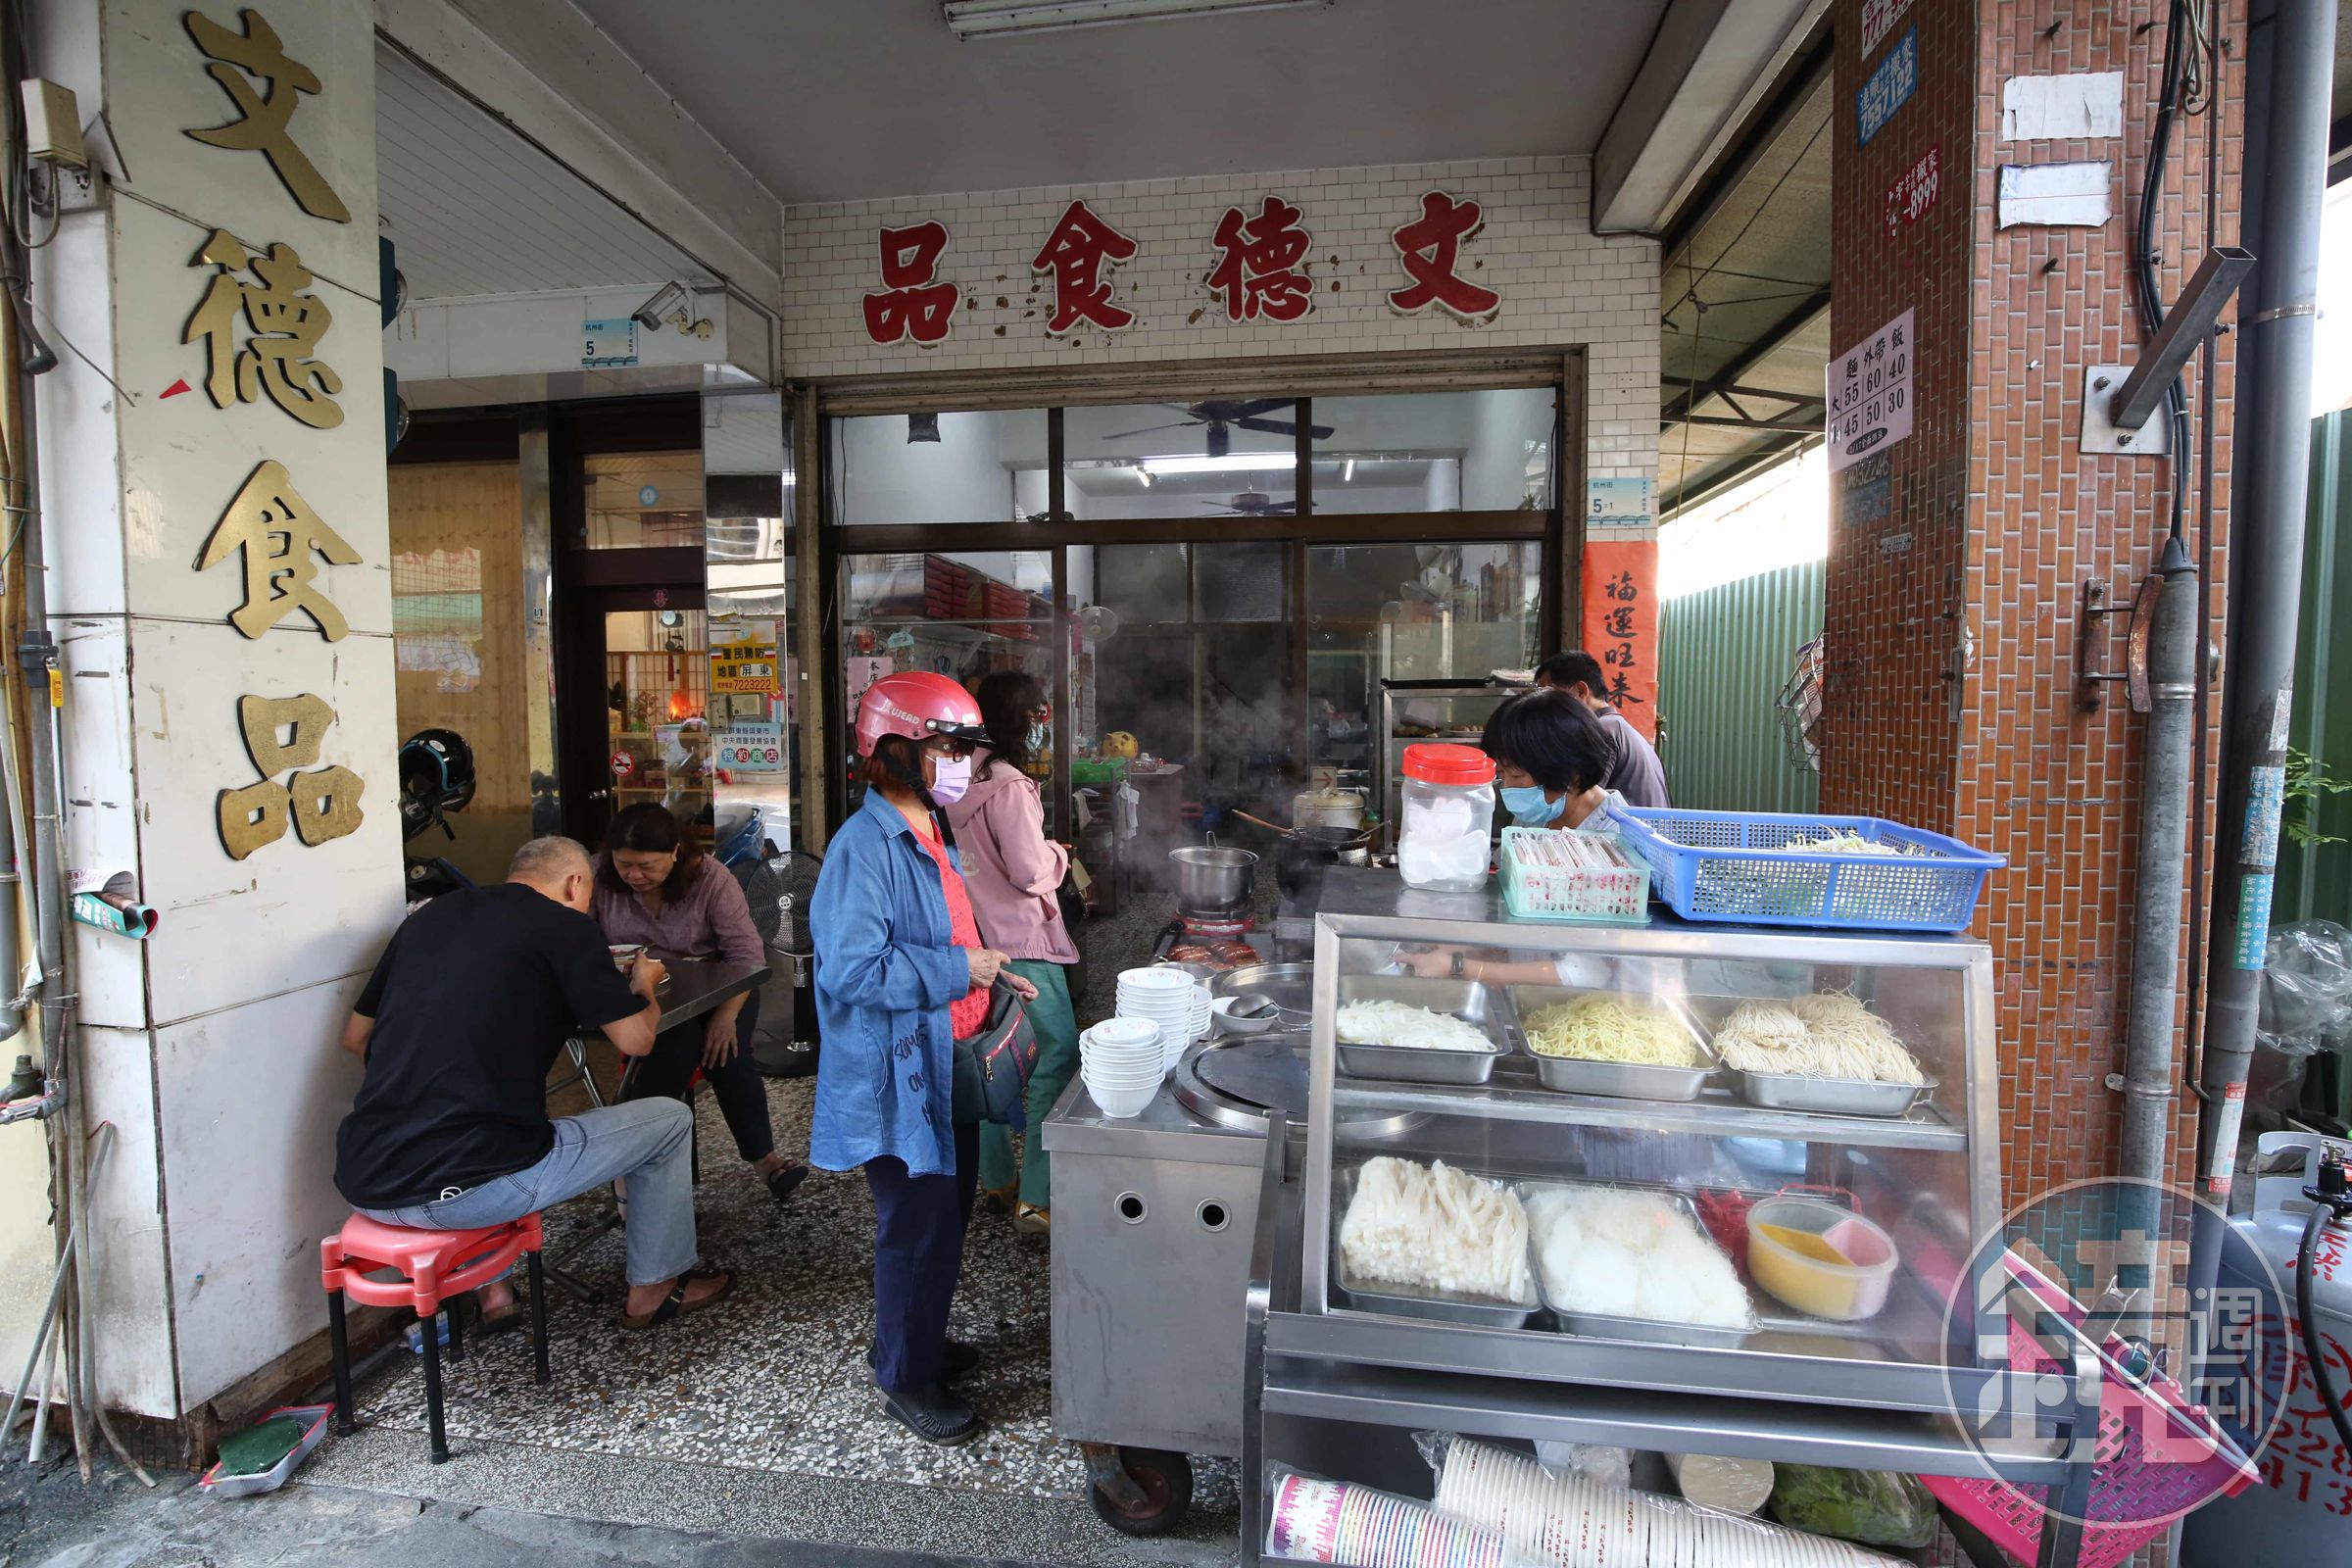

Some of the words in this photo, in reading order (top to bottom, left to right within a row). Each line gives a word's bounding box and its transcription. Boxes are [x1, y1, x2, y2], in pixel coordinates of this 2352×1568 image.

[1860, 58, 1913, 139] 7557122
[586, 340, 595, 356] 5
[1844, 381, 1859, 407] 55
[1866, 368, 1881, 393] 60
[1888, 353, 1905, 379] 40
[1844, 414, 1858, 437] 45
[1866, 401, 1881, 426] 50
[1888, 387, 1904, 414] 30
[182, 9, 365, 860] 文德食品
[733, 679, 771, 691] 7223222
[740, 663, 770, 677] 屏東
[721, 748, 779, 763] 特約商店
